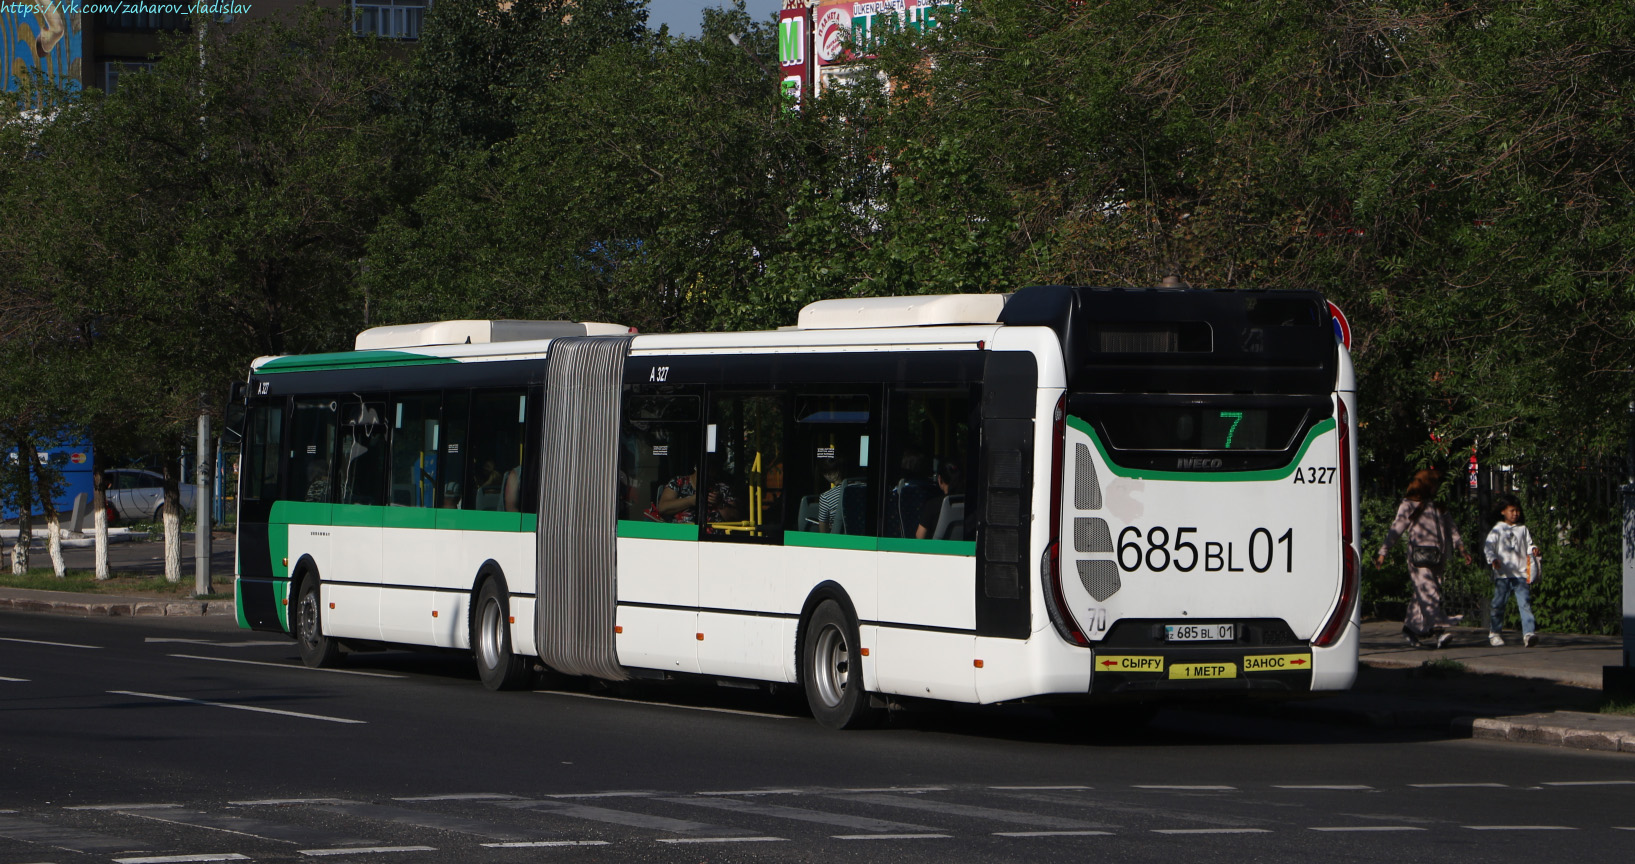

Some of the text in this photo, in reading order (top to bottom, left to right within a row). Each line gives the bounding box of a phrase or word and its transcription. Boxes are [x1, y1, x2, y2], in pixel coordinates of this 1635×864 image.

[656, 366, 670, 382] 327
[1220, 411, 1243, 449] 7
[1176, 457, 1223, 469] IVECO
[1308, 466, 1337, 485] 327
[1087, 607, 1106, 632] 70
[1177, 626, 1233, 639] 685 BL 01
[1121, 658, 1161, 669] СЫРҒУ
[1245, 657, 1285, 669] ЗАНОС
[1184, 666, 1225, 676] 1 МЕТР
